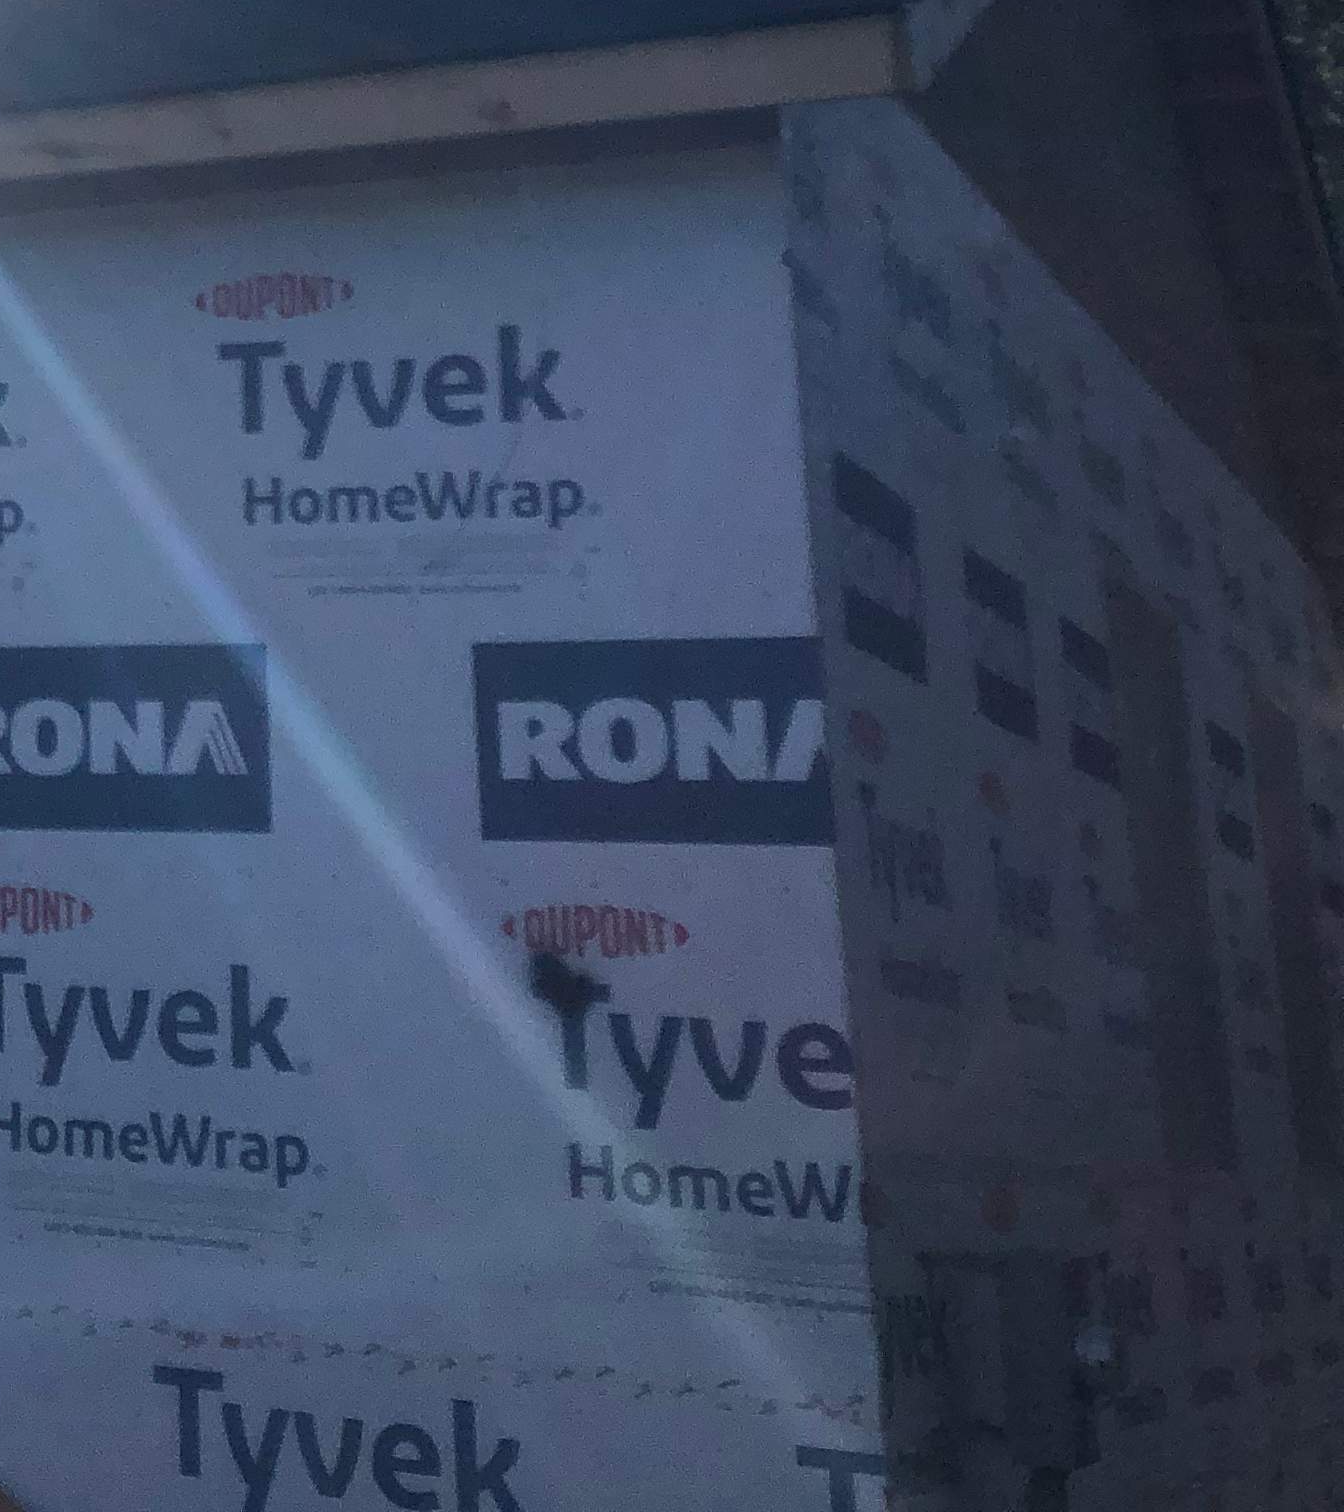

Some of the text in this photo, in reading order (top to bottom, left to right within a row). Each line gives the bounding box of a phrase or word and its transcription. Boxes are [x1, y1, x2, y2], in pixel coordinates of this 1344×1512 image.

[217, 326, 567, 459] Tyvek
[242, 471, 585, 528] HomeWrap
[154, 1365, 520, 1512] Tyvek
